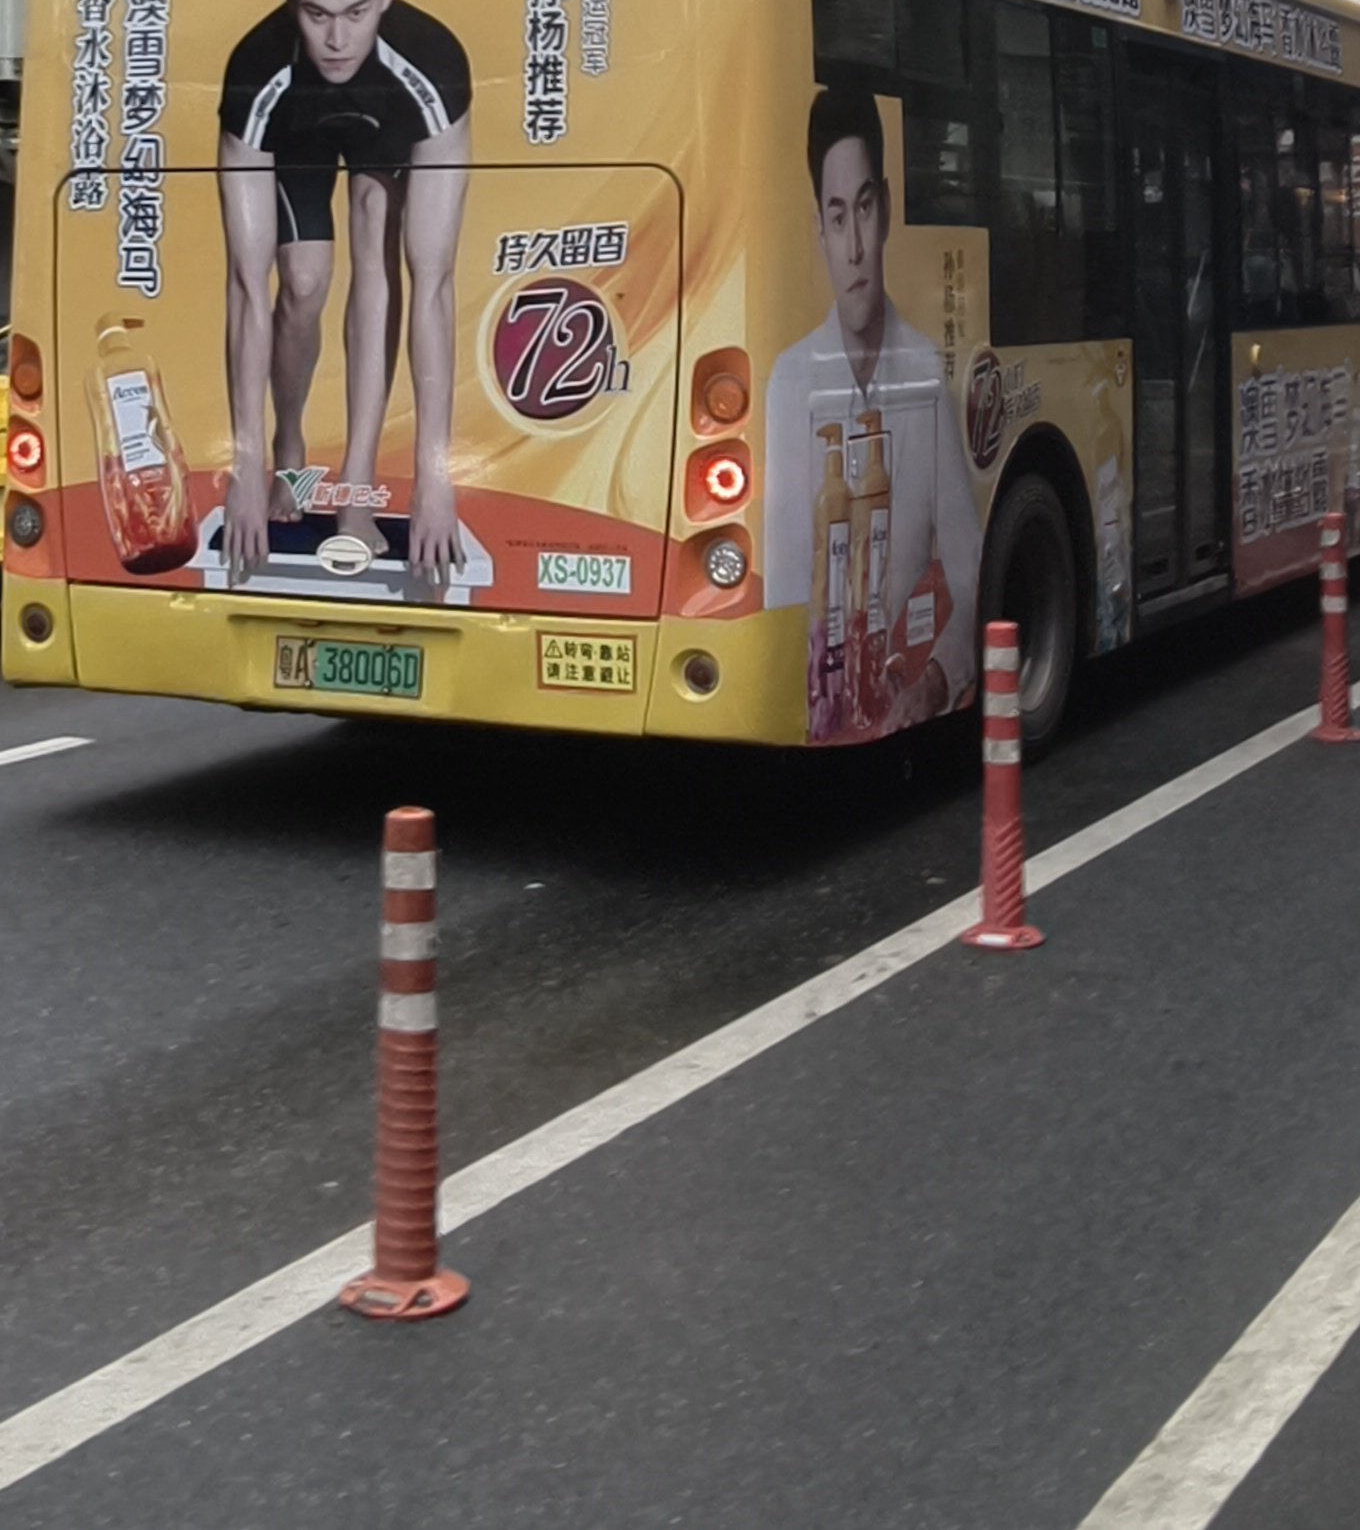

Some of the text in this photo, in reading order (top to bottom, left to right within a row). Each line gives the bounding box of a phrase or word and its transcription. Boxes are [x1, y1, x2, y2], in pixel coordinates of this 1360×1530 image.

[495, 224, 627, 272] 持久留香
[540, 555, 626, 588] XS-0937
